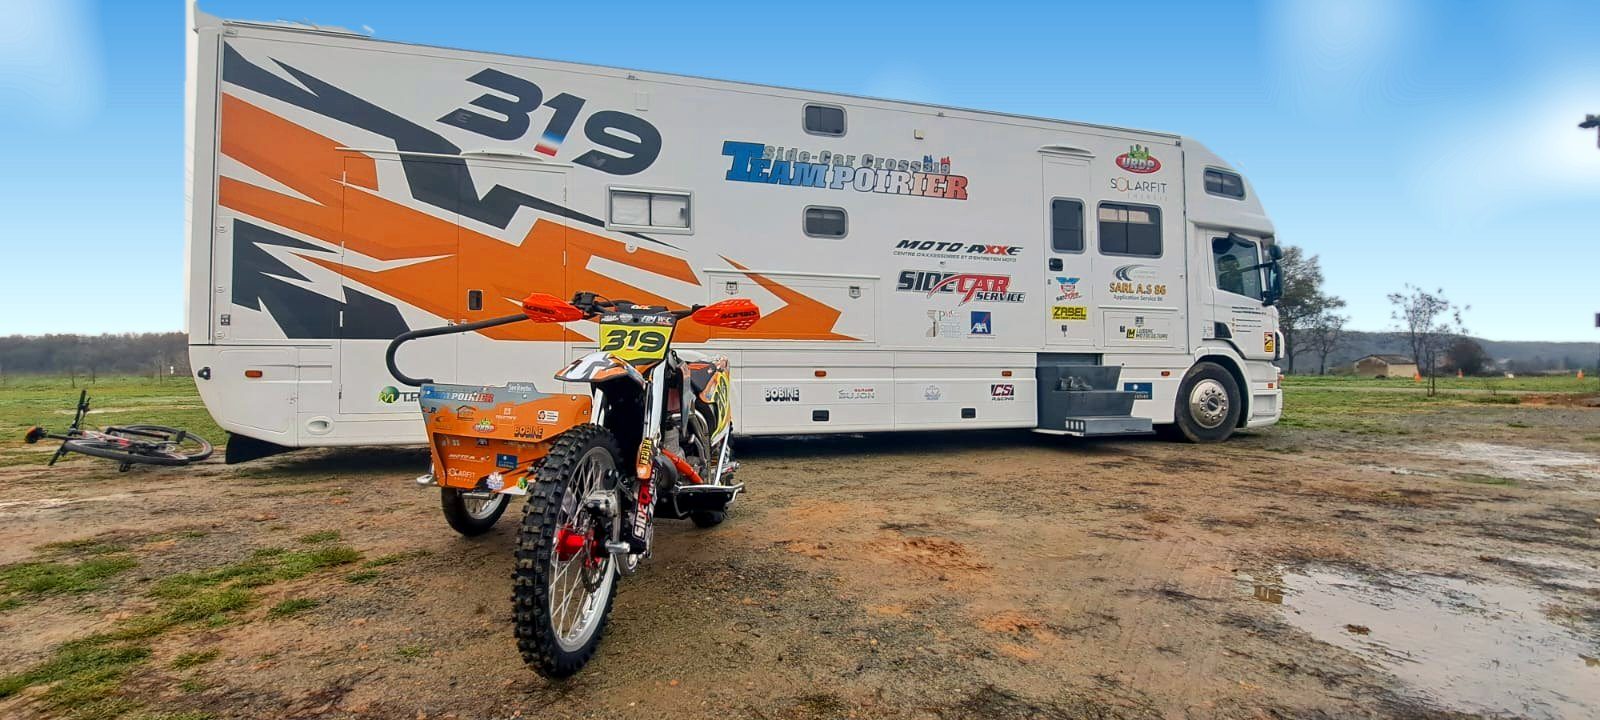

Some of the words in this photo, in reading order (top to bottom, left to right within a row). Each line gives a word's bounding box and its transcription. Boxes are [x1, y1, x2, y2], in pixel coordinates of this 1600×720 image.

[436, 67, 662, 176] 319
[763, 146, 856, 167] Side-Car
[861, 153, 925, 172] Cross
[722, 140, 828, 189] TEAM
[829, 165, 969, 200] POIRIER
[1110, 176, 1167, 193] SOLARFIT
[895, 239, 1024, 256] MOTO-AXXE
[974, 291, 1025, 303] SERVICE
[1109, 282, 1135, 293] SARL
[1154, 284, 1167, 295] 86
[1053, 306, 1087, 317] ZABEL
[602, 329, 666, 353] 319
[765, 386, 799, 401] BOBINE
[513, 425, 543, 439] BOBINE
